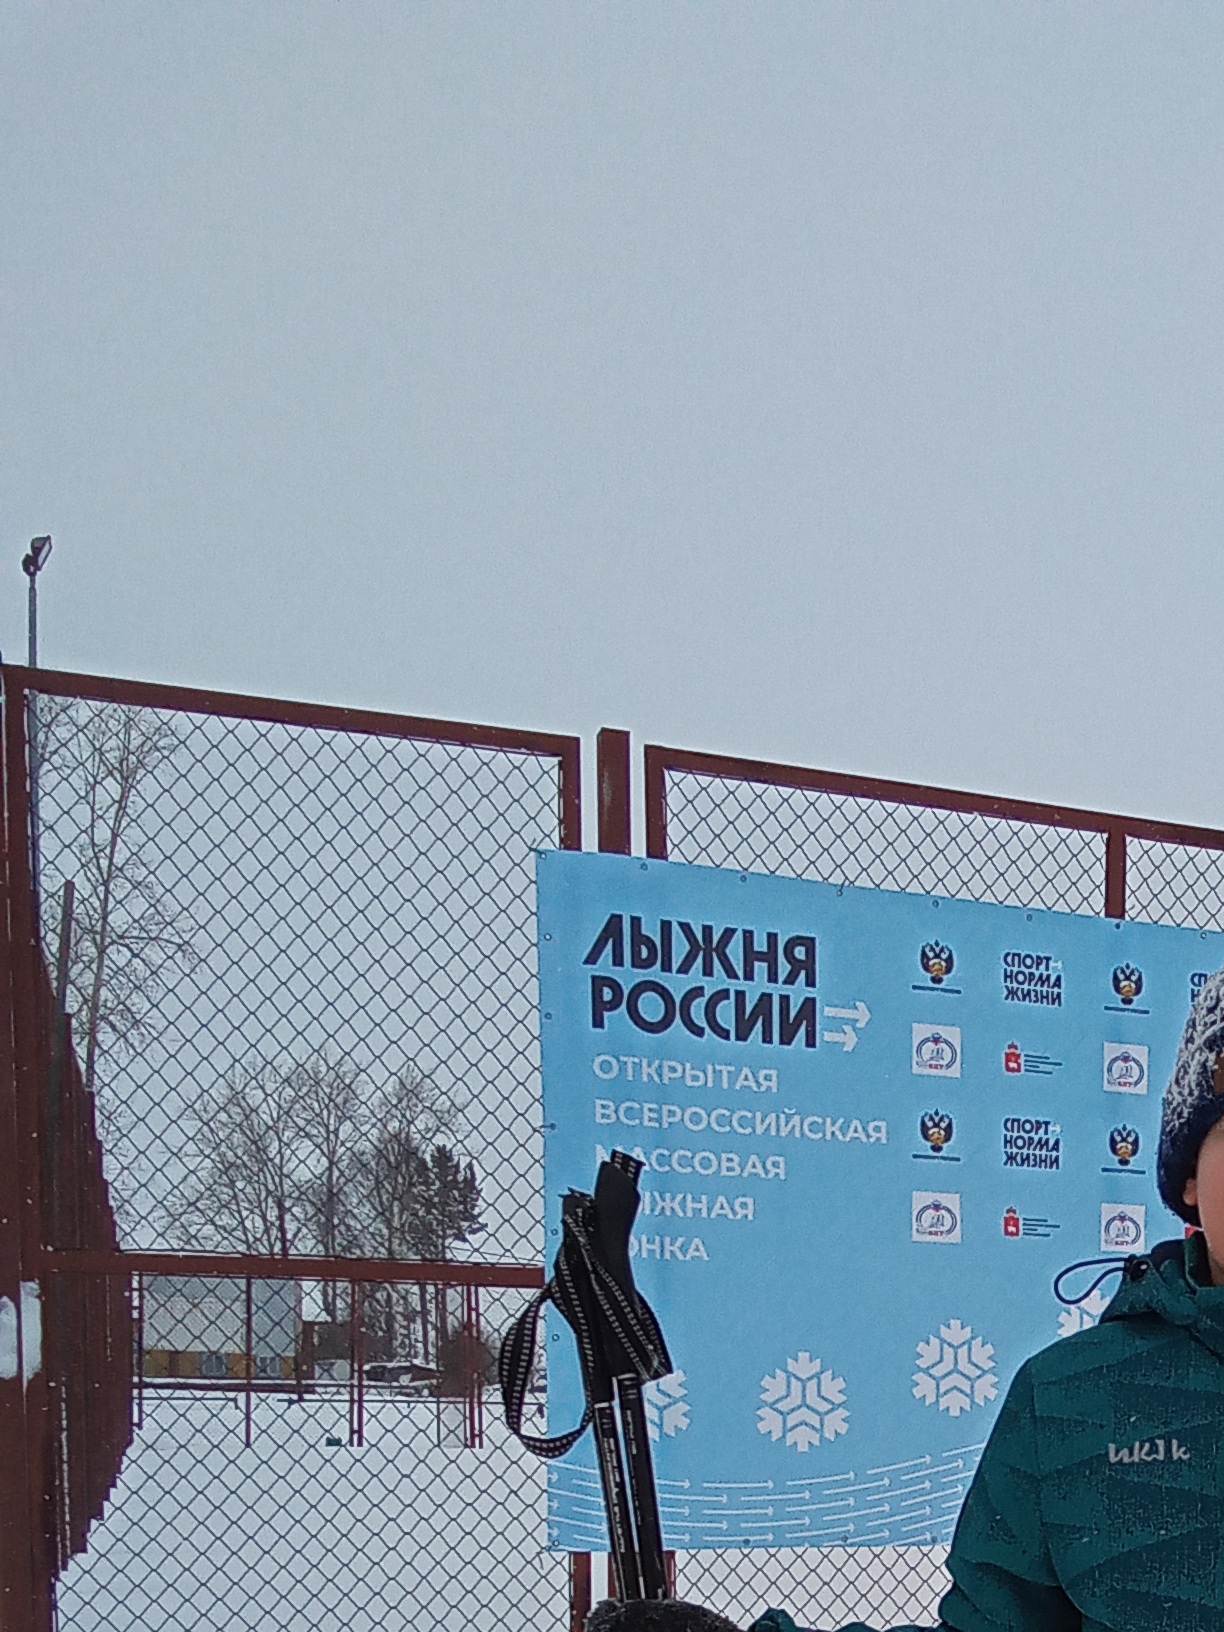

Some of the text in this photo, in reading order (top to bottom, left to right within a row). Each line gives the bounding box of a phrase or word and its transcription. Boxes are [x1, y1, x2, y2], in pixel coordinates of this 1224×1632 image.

[583, 912, 818, 989] ЛЫЖНЯ
[1003, 951, 1051, 972] СПОРТ
[1003, 968, 1062, 990] НОРМА
[1003, 985, 1062, 1007] ЖИЗНИ
[590, 974, 818, 1049] РОССИИ
[592, 1053, 778, 1093] ОТКРЫТАЯ
[594, 1097, 888, 1144] ВСЕРОССИЙСКАЯ
[1003, 1117, 1050, 1136] СПОРТ
[1003, 1134, 1060, 1153] НОРМА
[1003, 1151, 1060, 1170] ЖИЗНИ
